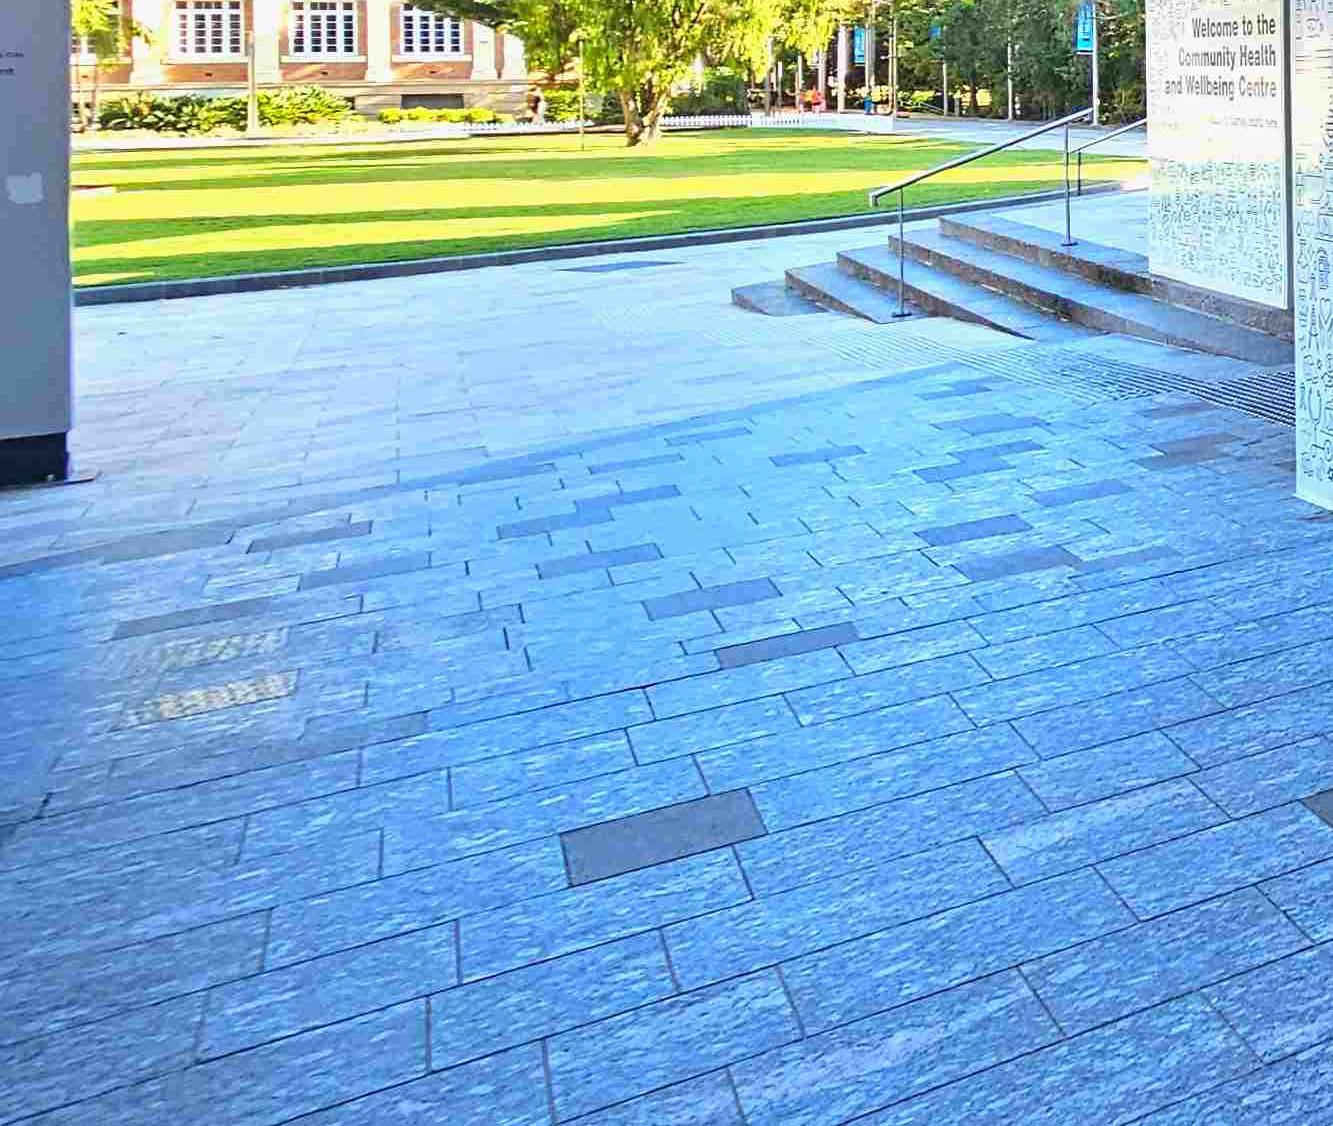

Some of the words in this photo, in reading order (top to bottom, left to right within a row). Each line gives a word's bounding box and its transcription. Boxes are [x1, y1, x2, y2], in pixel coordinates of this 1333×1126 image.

[1191, 17, 1239, 38] Welcome
[1242, 15, 1253, 35] to
[1257, 13, 1276, 34] the
[1178, 46, 1236, 71] Community
[1240, 44, 1276, 66] Health
[1165, 75, 1182, 94] and
[1186, 74, 1234, 101] Wellbeing
[1239, 75, 1277, 97] Centre
